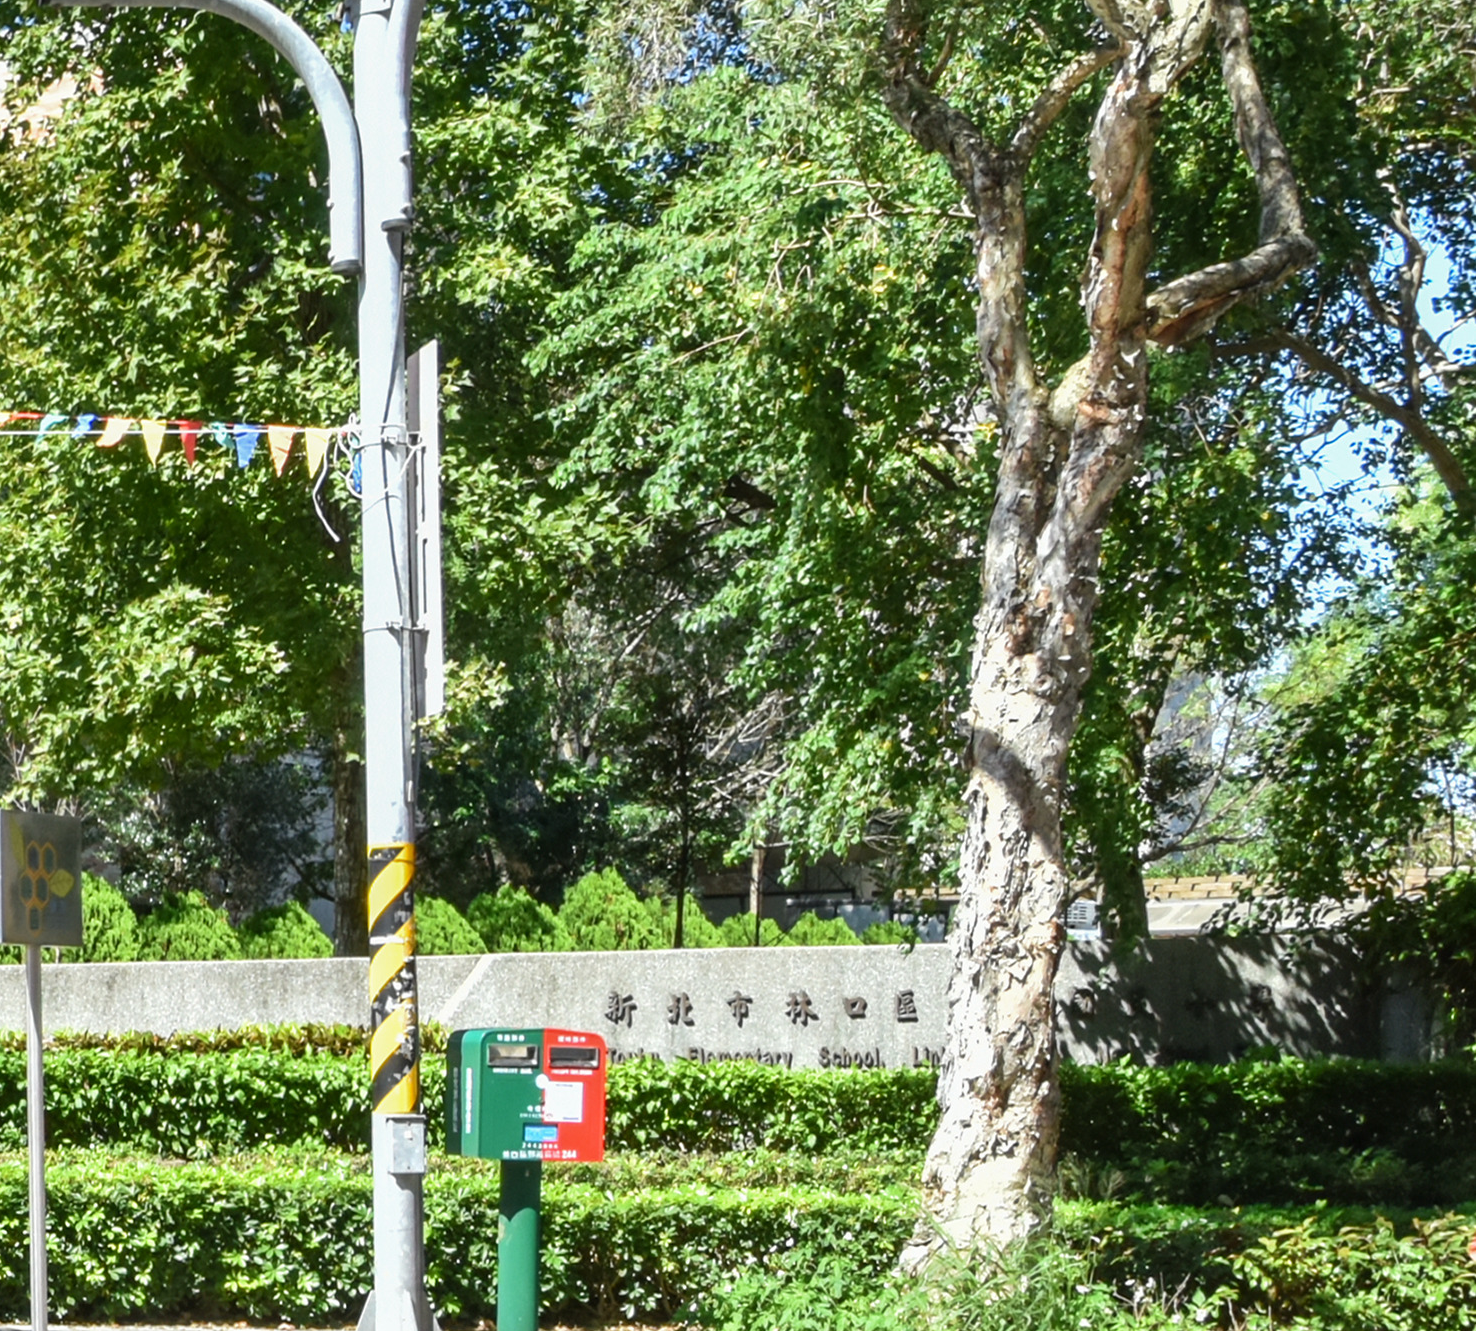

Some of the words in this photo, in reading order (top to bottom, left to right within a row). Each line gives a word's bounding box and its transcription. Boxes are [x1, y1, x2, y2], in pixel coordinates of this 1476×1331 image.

[604, 989, 920, 1028] 新北市林口區
